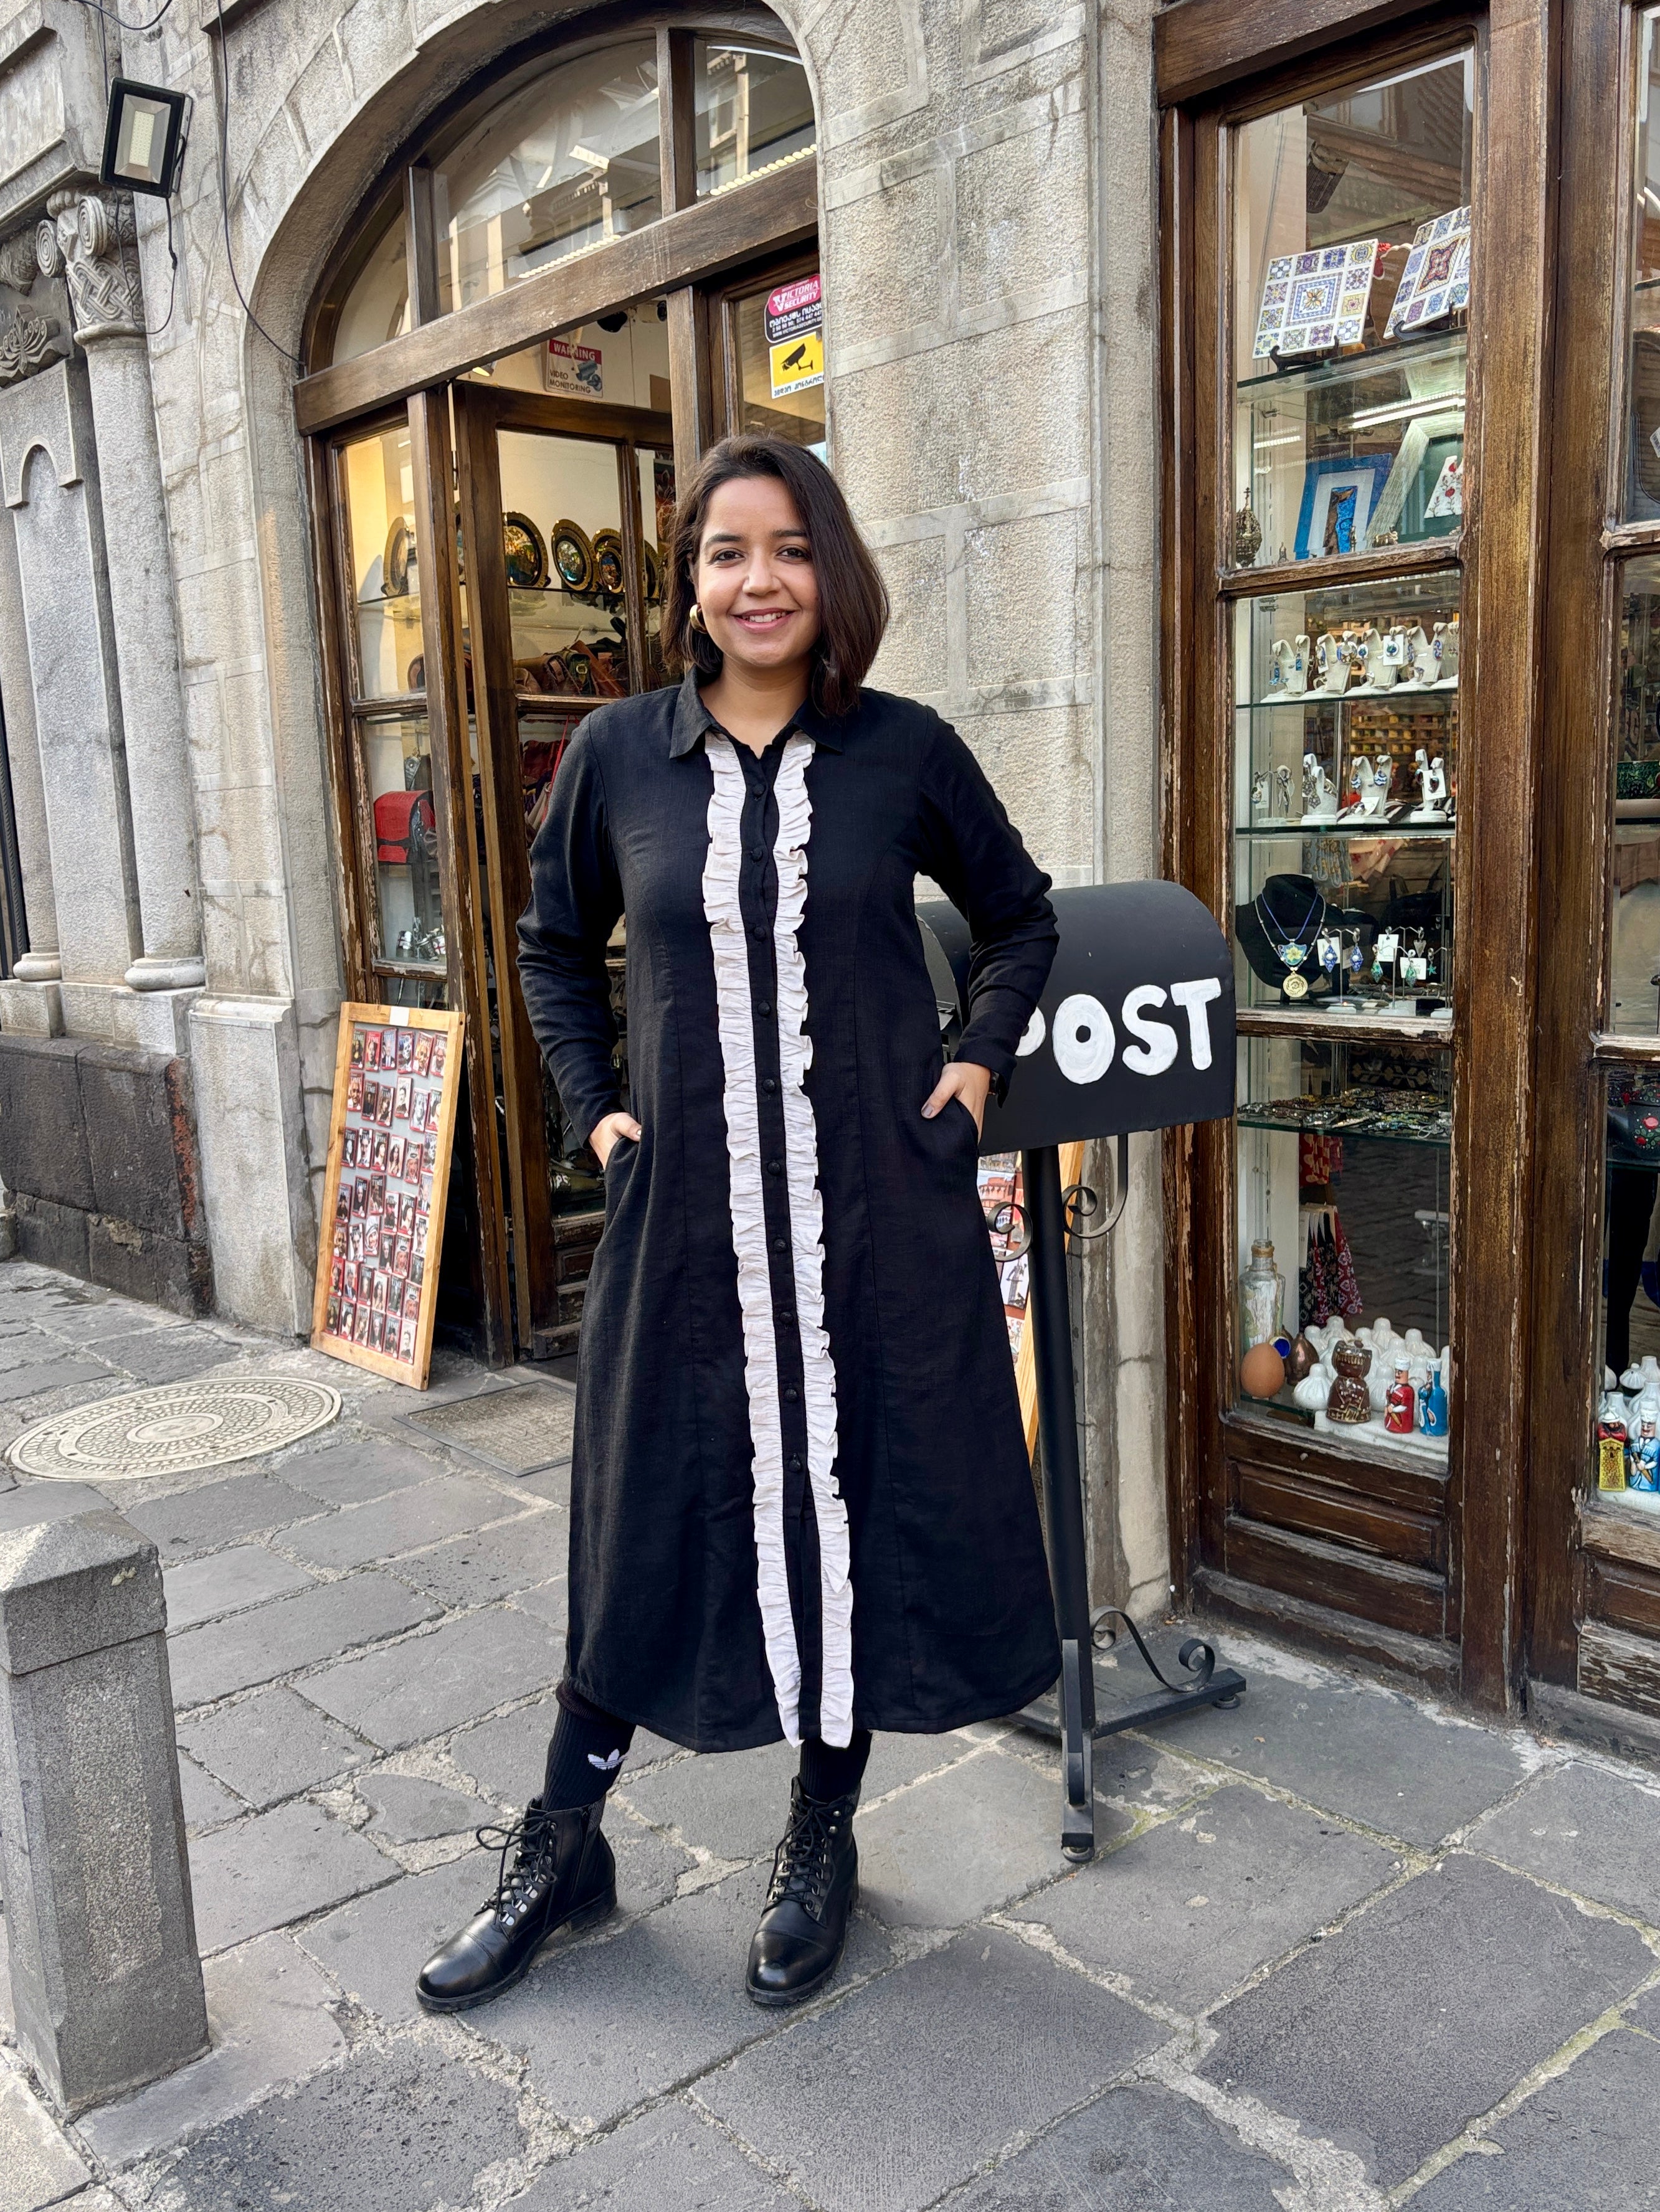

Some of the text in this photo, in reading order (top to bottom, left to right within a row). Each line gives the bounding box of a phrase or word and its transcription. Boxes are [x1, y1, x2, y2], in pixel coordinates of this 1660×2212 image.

[772, 280, 820, 311] VICTORIA
[784, 291, 817, 310] SECURITY
[549, 369, 569, 380] VIDEO
[549, 378, 591, 394] MONITORING
